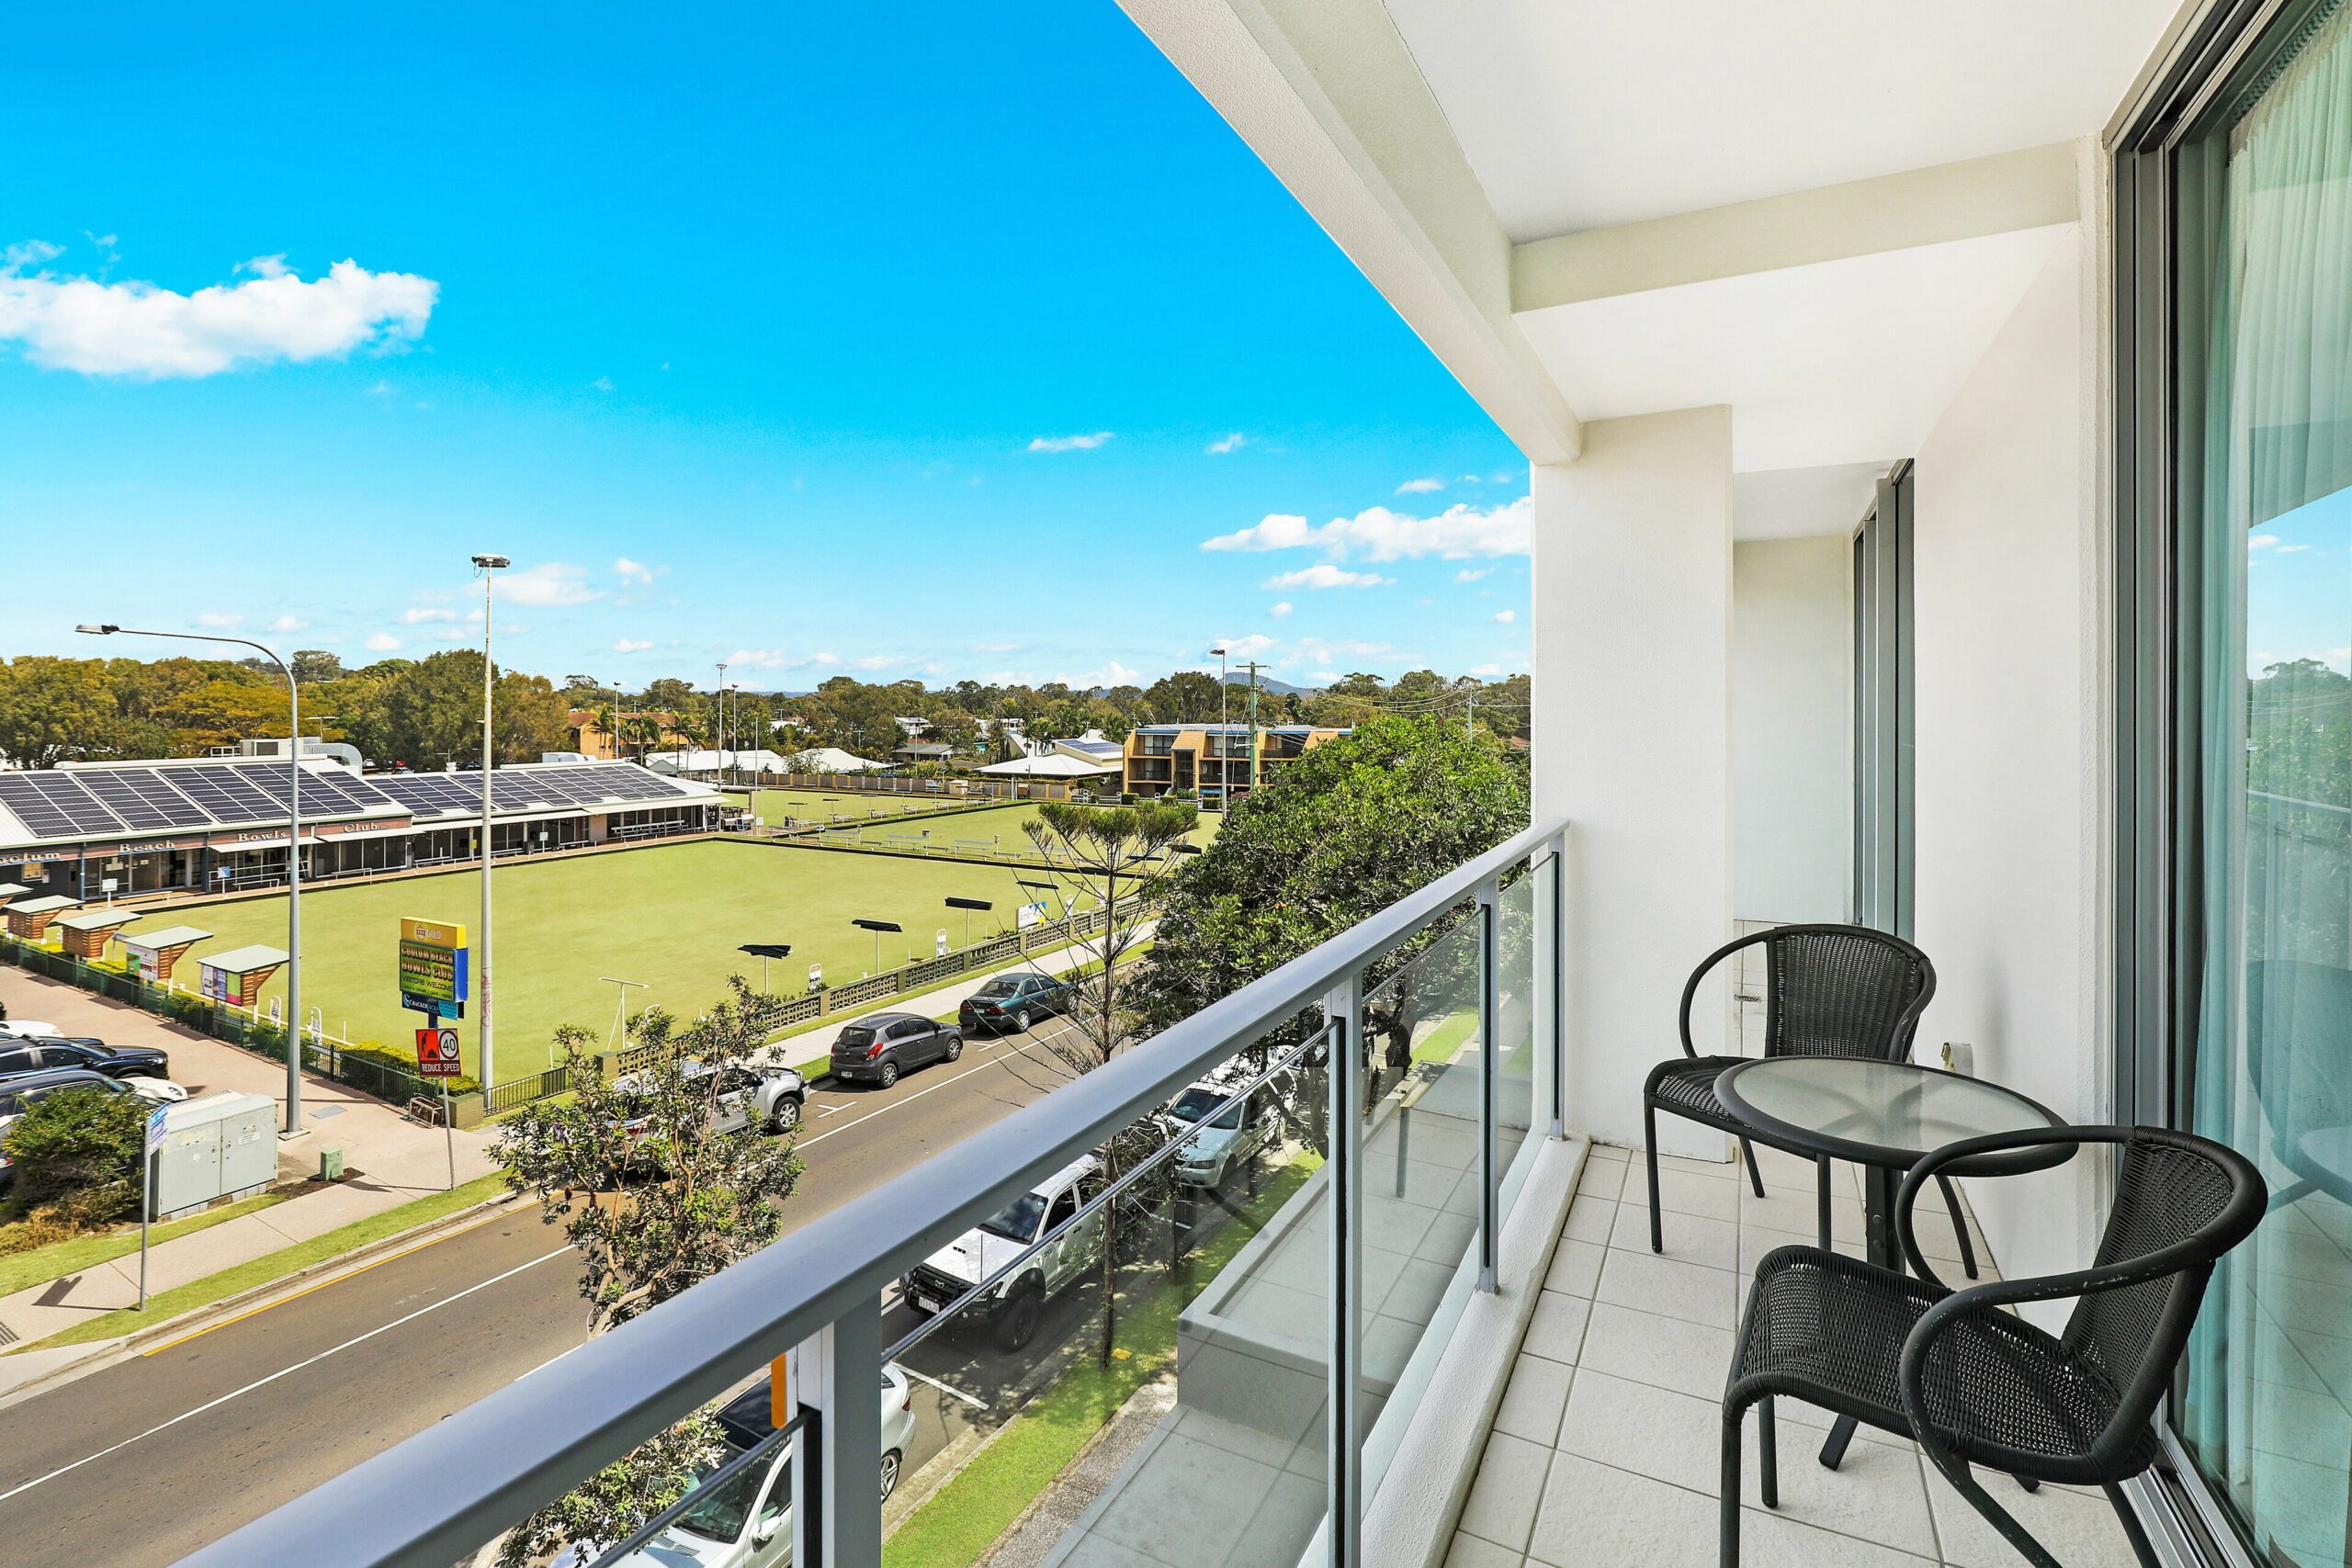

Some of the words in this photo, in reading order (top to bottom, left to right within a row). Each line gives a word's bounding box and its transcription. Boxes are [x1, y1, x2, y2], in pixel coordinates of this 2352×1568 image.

[119, 840, 175, 852] Beach
[238, 830, 287, 841] Bowls
[345, 822, 378, 832] Club
[401, 945, 430, 962] COOLUM
[431, 950, 453, 965] BEACH
[401, 959, 430, 976] BOWLS
[433, 965, 453, 981] CLUB
[427, 979, 453, 991] WELCOME
[443, 1038, 456, 1052] 40
[422, 1064, 441, 1072] REDUCE
[443, 1064, 459, 1072] SPEED
